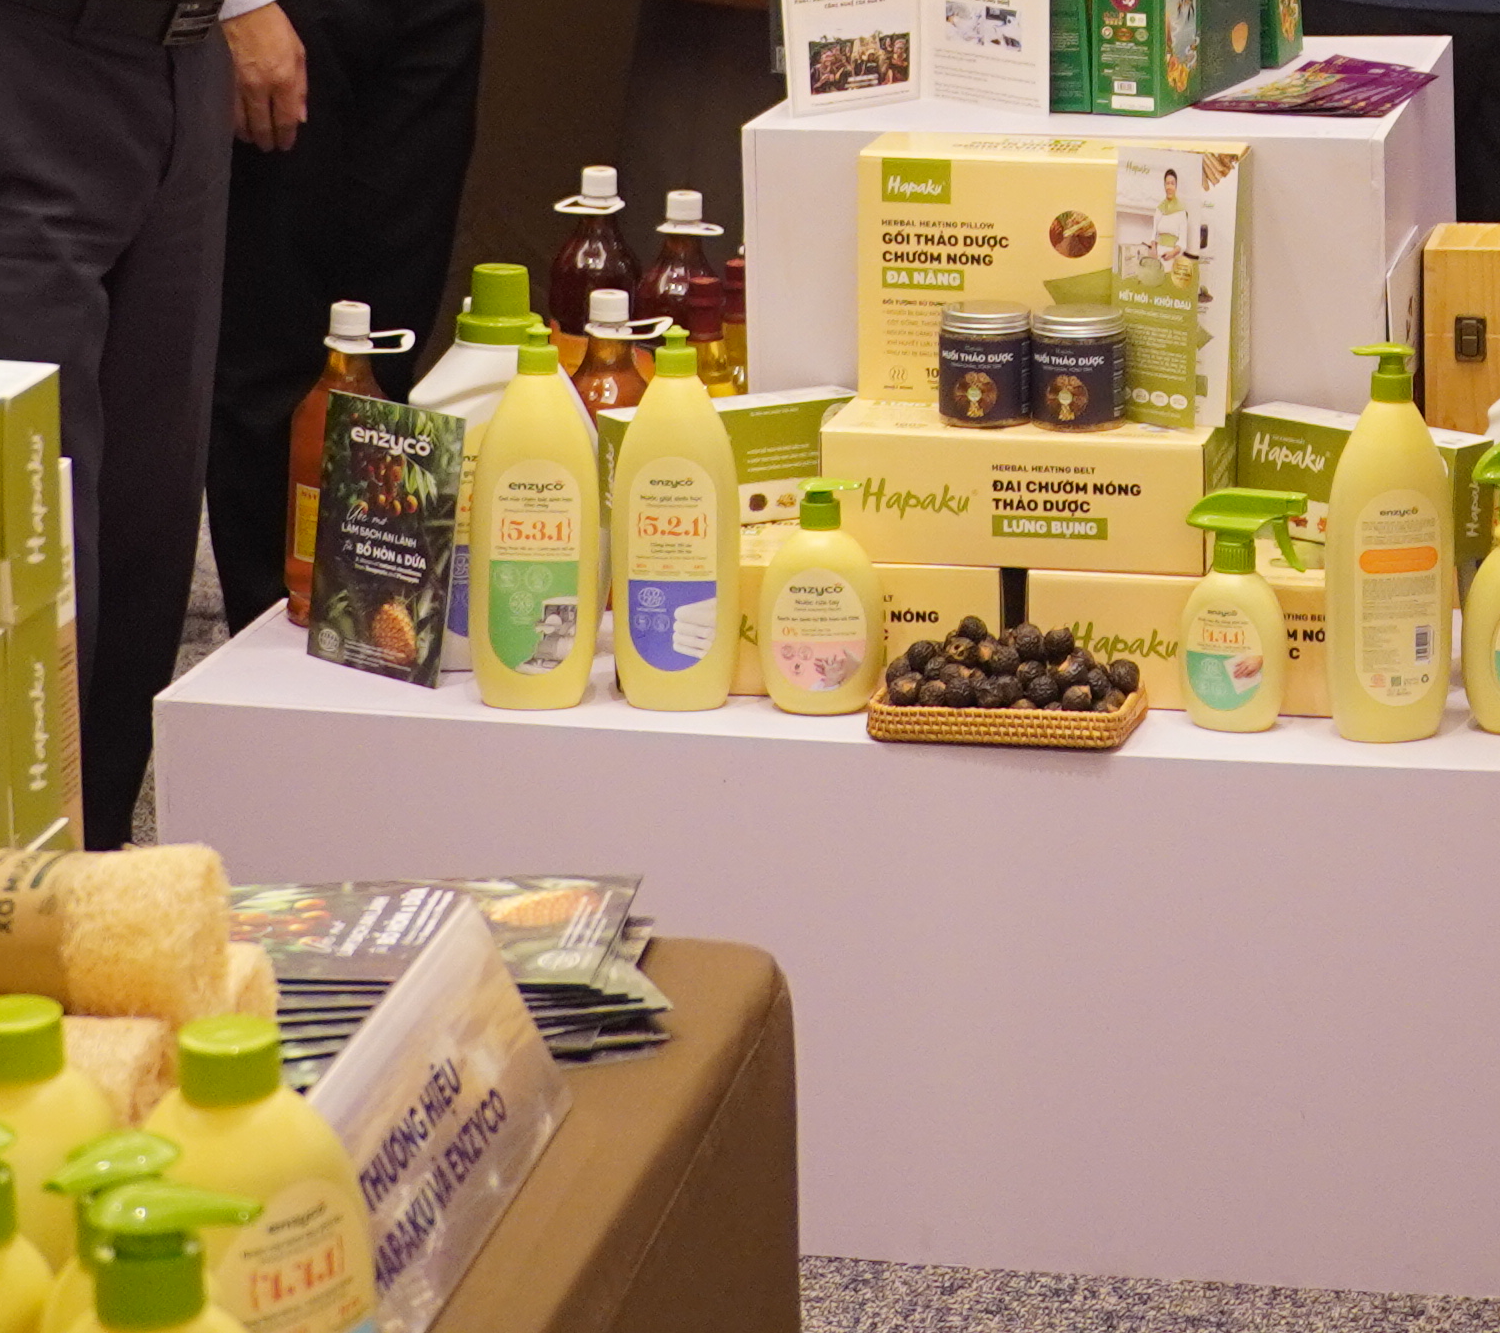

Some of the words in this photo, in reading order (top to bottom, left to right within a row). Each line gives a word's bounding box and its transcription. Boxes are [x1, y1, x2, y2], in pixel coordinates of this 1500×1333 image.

[888, 175, 943, 200] Hapaku
[881, 219, 916, 227] HERBAL
[919, 221, 958, 229] HEATING
[882, 228, 910, 245] GỐI
[914, 230, 959, 247] THẢO
[963, 234, 1010, 252] DƯỢC
[882, 249, 942, 264] CHƯỜM
[946, 251, 994, 266] NÓNG
[886, 270, 910, 285] ĐA
[960, 350, 987, 363] THẢO
[987, 352, 1014, 364] DƯỢC
[1050, 354, 1077, 366] THẢO
[1078, 356, 1105, 367] DƯỢC
[351, 425, 431, 457] enzyco
[1252, 431, 1326, 473] Hapaku
[991, 464, 1029, 473] HERBAL
[1031, 465, 1072, 474] HEATING
[1074, 466, 1096, 475] BELT
[508, 480, 565, 493] enzyco
[649, 477, 694, 489] enzyco
[992, 479, 1021, 493] ĐAI
[1025, 479, 1088, 495] CHƯỜM
[1092, 481, 1142, 496] NÓNG
[26, 434, 48, 564] Hapaku
[862, 477, 971, 521] Hapaku
[992, 495, 1039, 513] THẢO
[1043, 499, 1091, 516] DƯỢC
[1380, 506, 1419, 517] enzyco
[500, 517, 574, 543] {5.3.1}
[637, 512, 709, 539] {5.2.1}
[1003, 518, 1047, 534] LƯNG
[1051, 520, 1098, 539] BỤNG
[789, 583, 843, 596] enzyco
[890, 607, 939, 623] NÓNG
[1071, 621, 1179, 661] Hapaku
[28, 661, 50, 791] Hapaku
[444, 1087, 507, 1184] ENZYCO
